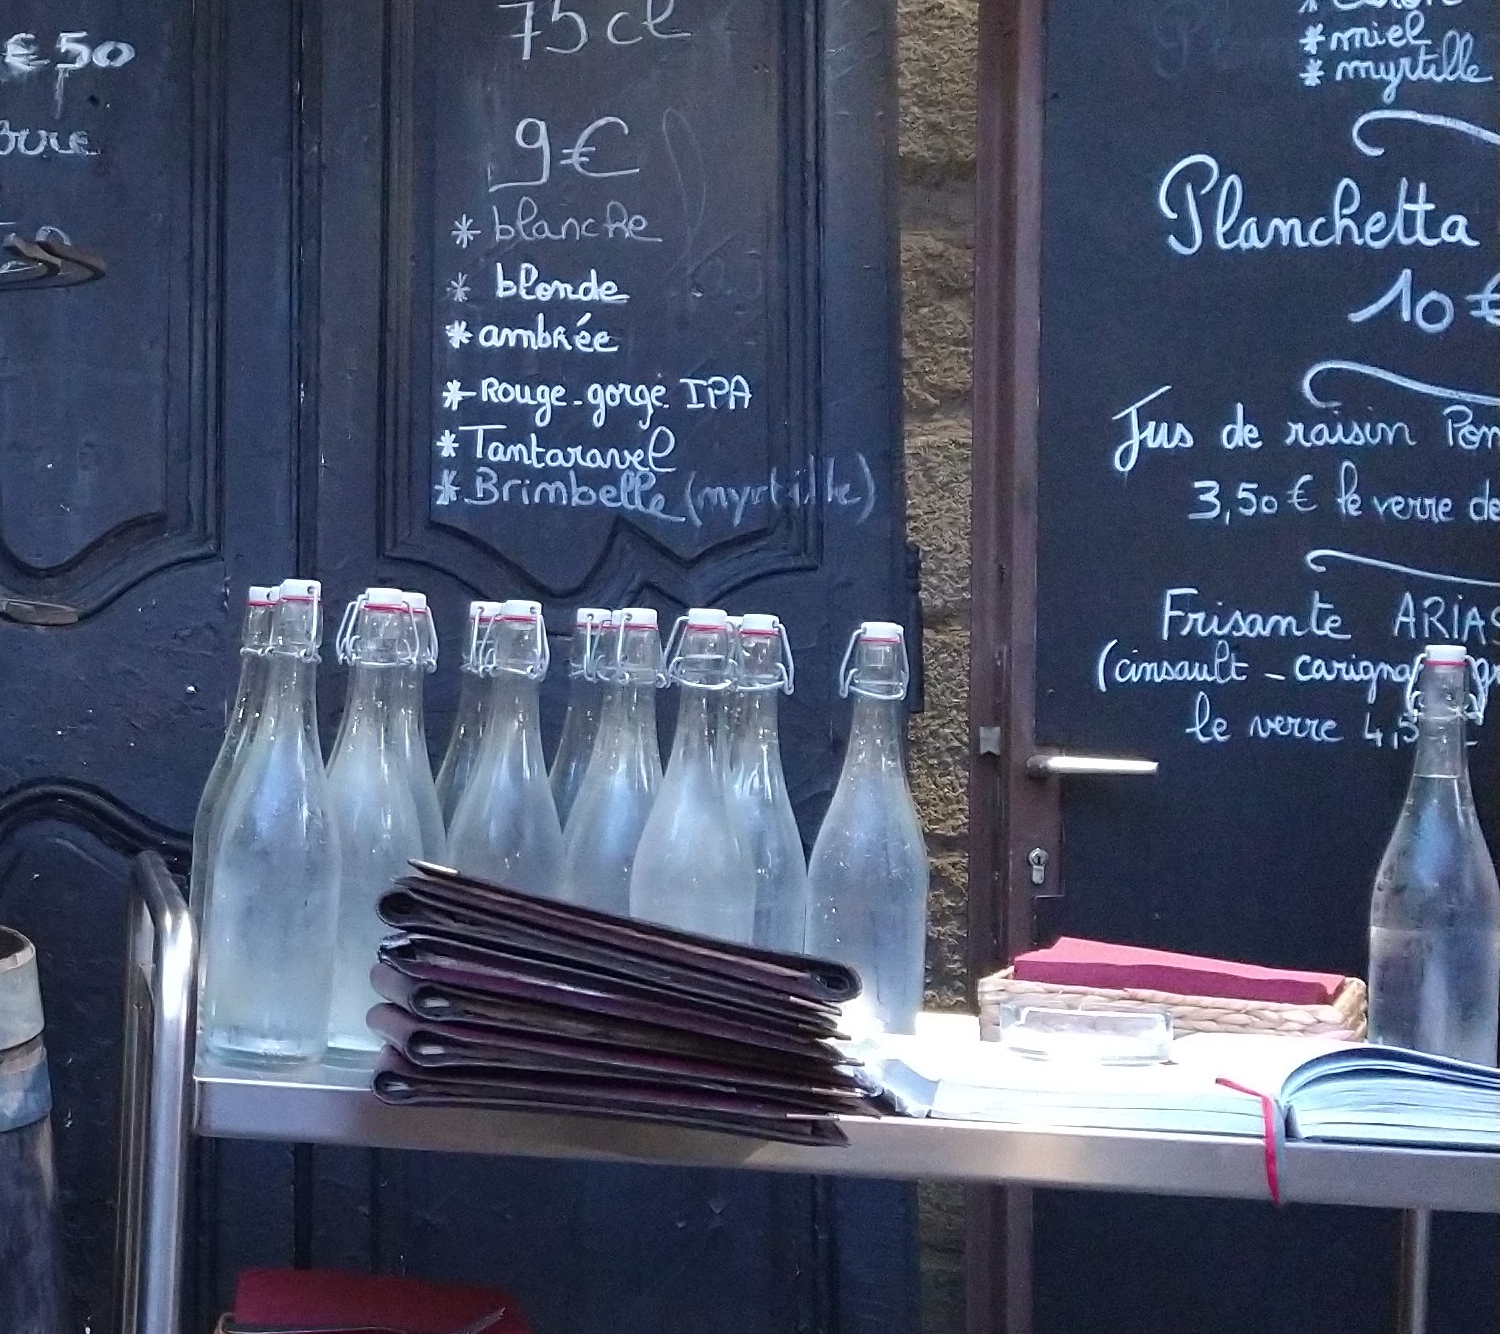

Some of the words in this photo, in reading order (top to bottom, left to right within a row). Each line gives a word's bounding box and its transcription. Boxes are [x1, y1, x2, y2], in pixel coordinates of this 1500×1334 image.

[1330, 9, 1432, 55] miel
[1335, 32, 1493, 104] myrtille
[492, 195, 663, 243] blanche
[1158, 153, 1480, 256] Planchetta
[496, 262, 630, 304] blonde
[679, 375, 753, 410] IPA
[1112, 384, 1195, 473] Jus
[1221, 402, 1264, 451] de
[1284, 406, 1418, 448] raisin
[464, 467, 687, 523] Brimbelle
[1336, 460, 1363, 518] le
[1373, 493, 1454, 524] verre
[1161, 587, 1352, 641] Frisante
[1295, 650, 1424, 705] carigna
[1186, 691, 1230, 744] le
[1249, 713, 1345, 743] verre
